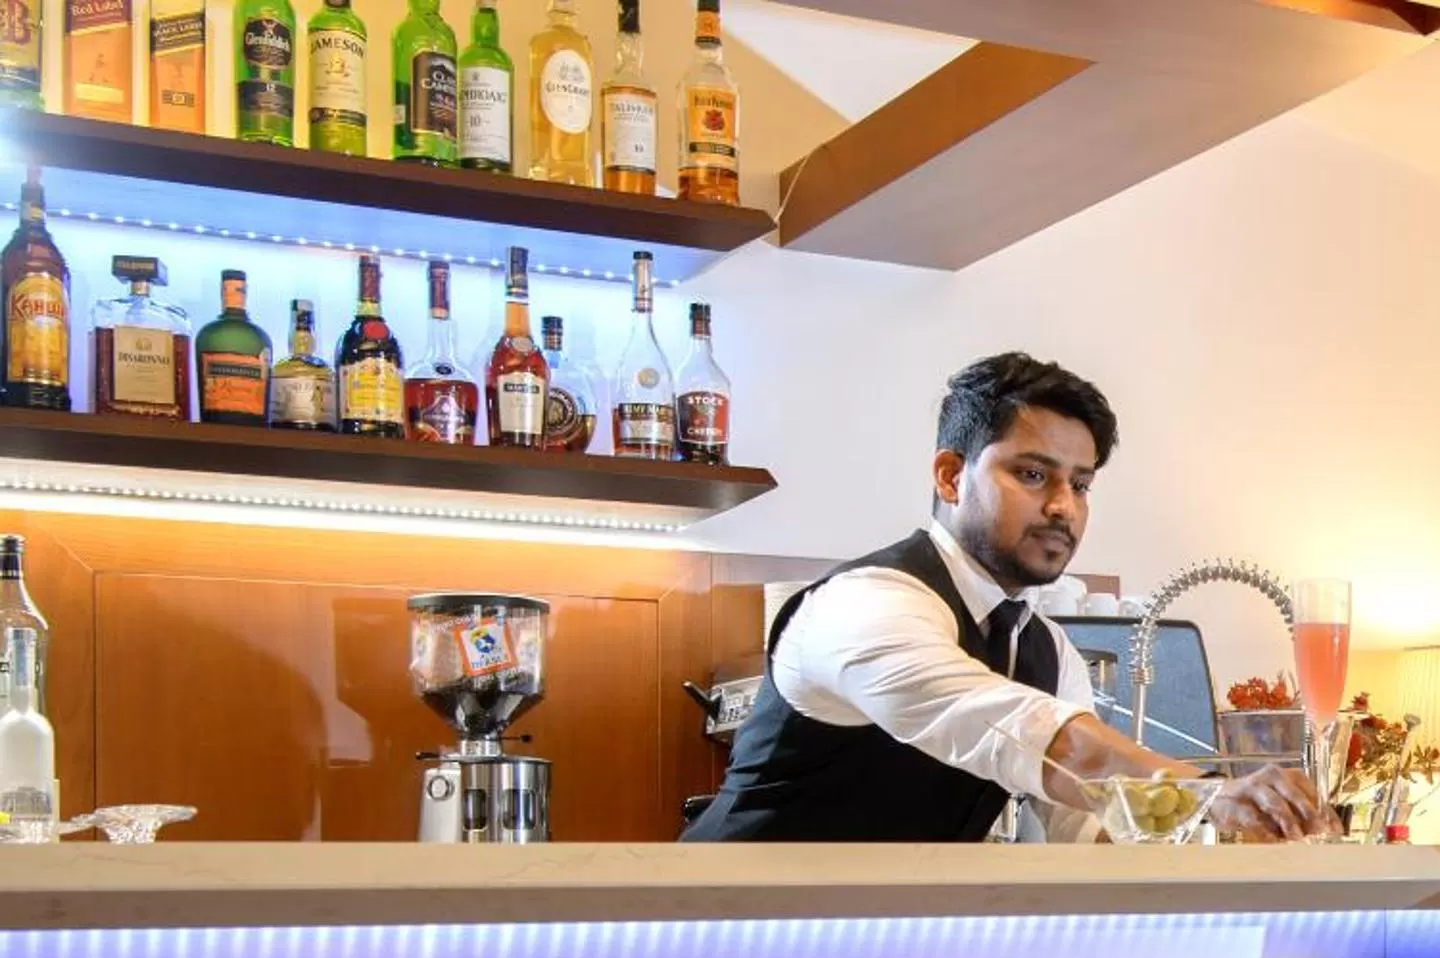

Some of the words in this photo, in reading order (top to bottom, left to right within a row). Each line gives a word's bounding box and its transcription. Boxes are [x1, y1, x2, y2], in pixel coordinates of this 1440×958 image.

[72, 3, 94, 16] Red
[310, 37, 364, 57] JAMESON
[118, 351, 170, 366] DISARONNO
[687, 396, 724, 406] STOCK
